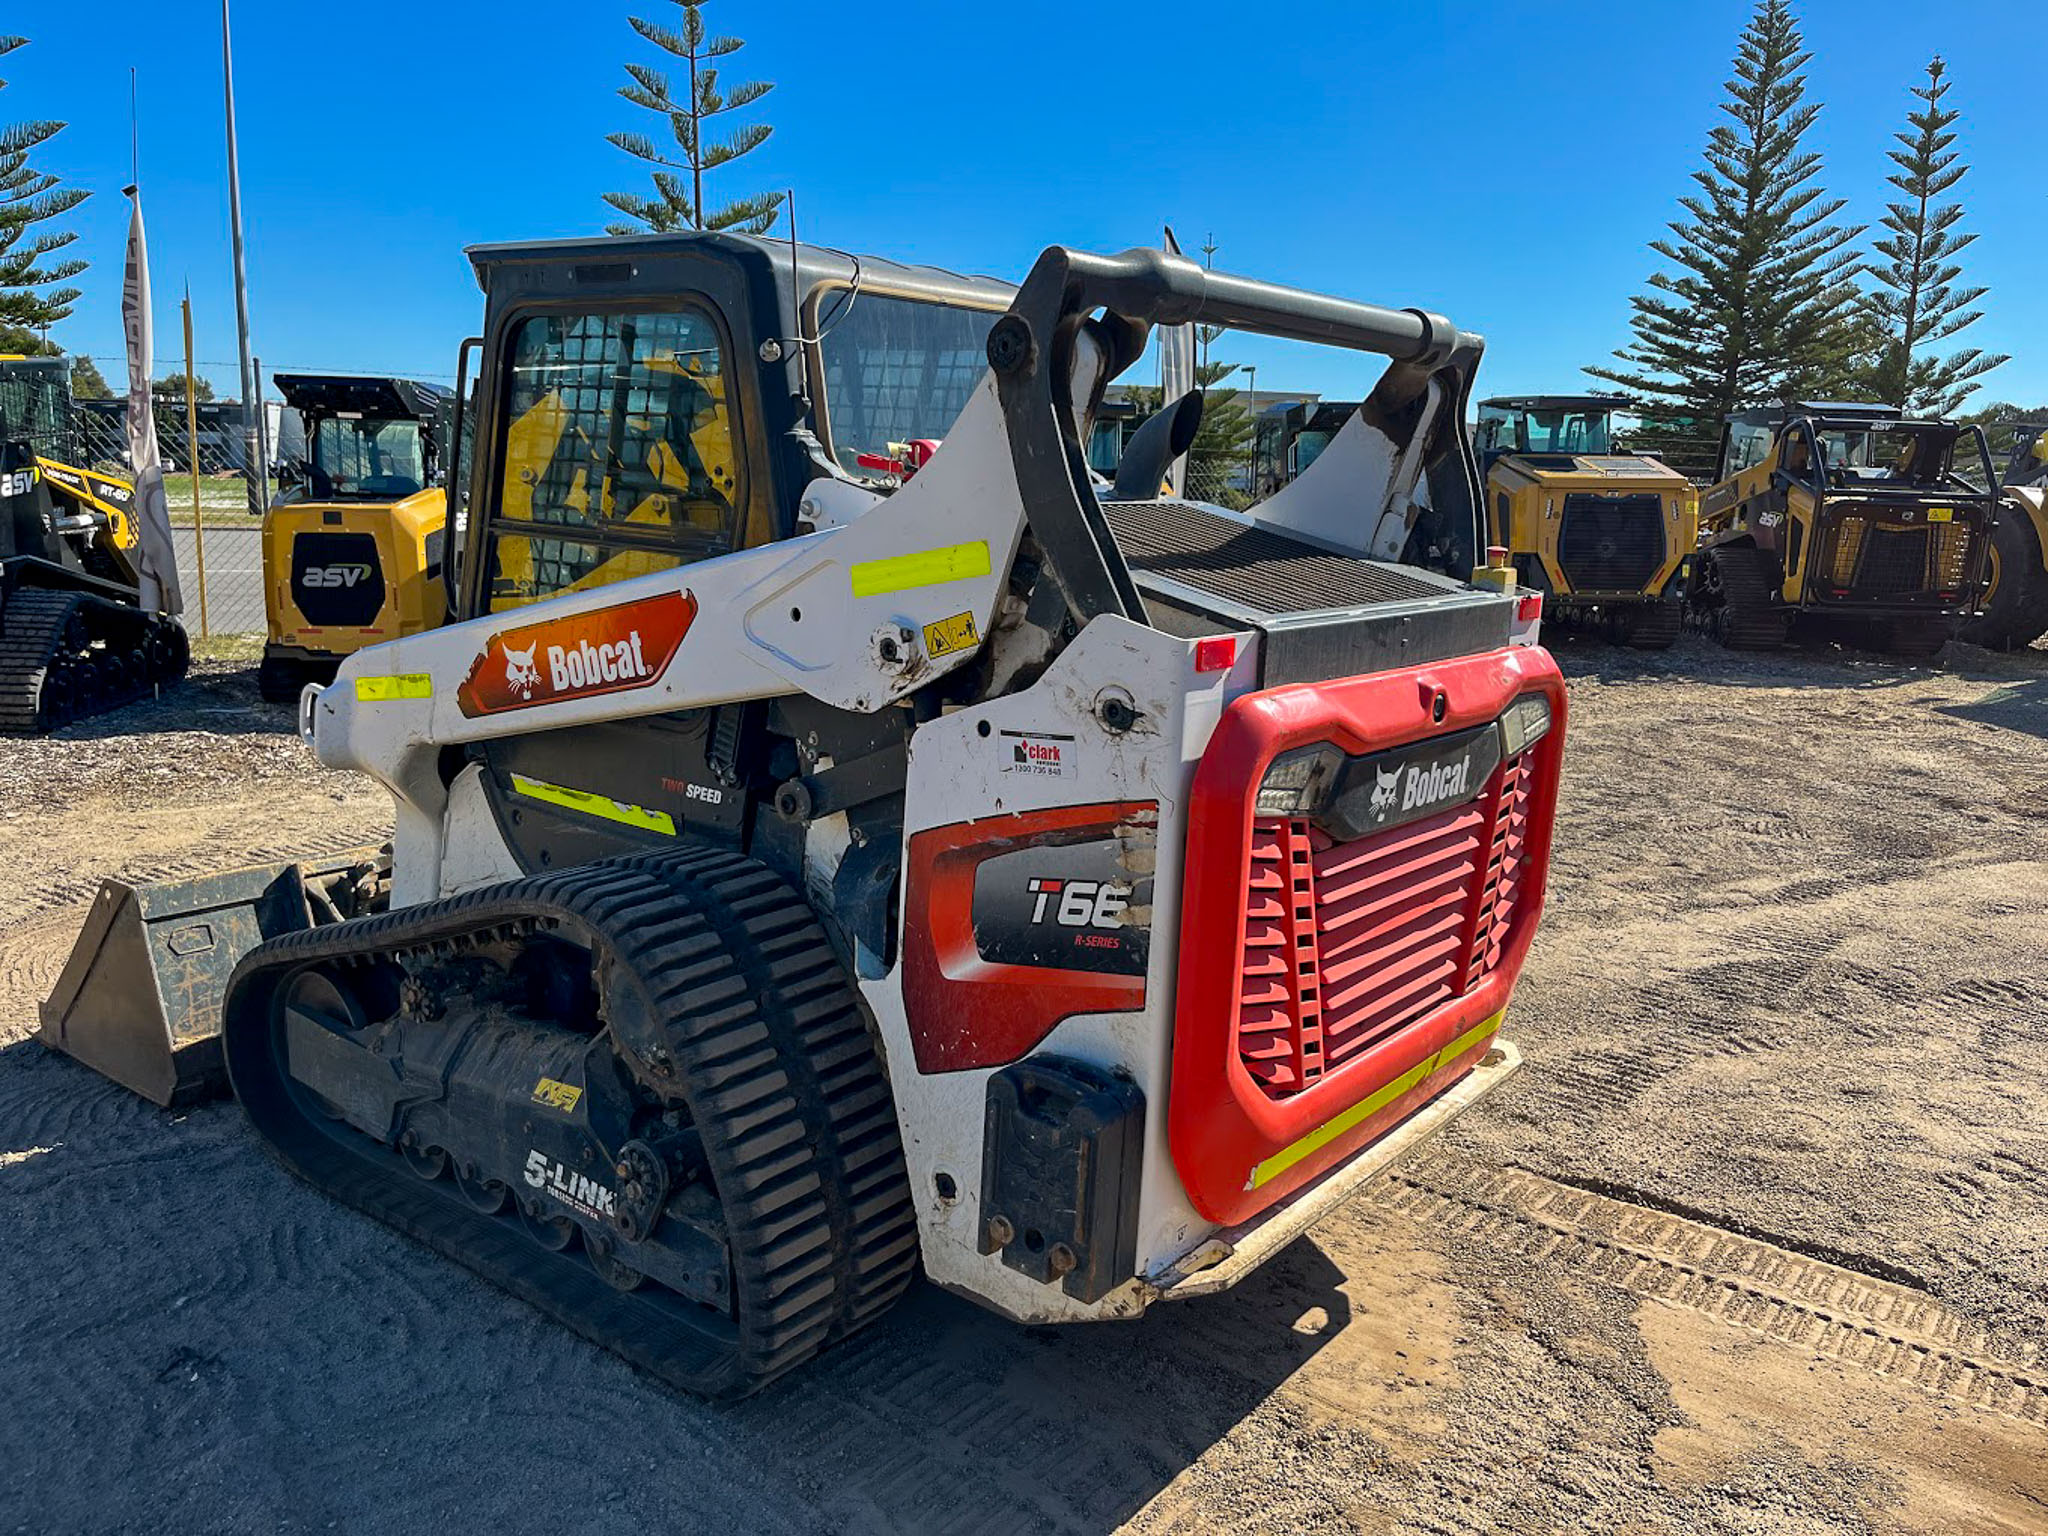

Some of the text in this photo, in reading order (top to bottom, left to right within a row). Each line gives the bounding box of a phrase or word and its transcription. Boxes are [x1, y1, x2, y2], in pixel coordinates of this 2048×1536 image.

[1, 471, 34, 497] asv
[302, 566, 363, 587] asv
[547, 631, 646, 691] Bobcat
[1029, 744, 1060, 761] clark
[661, 777, 722, 804] TWO SPEED
[1402, 754, 1470, 811] Bobcat
[1074, 934, 1121, 949] R-SERIES
[523, 1149, 618, 1218] 5-LINK
